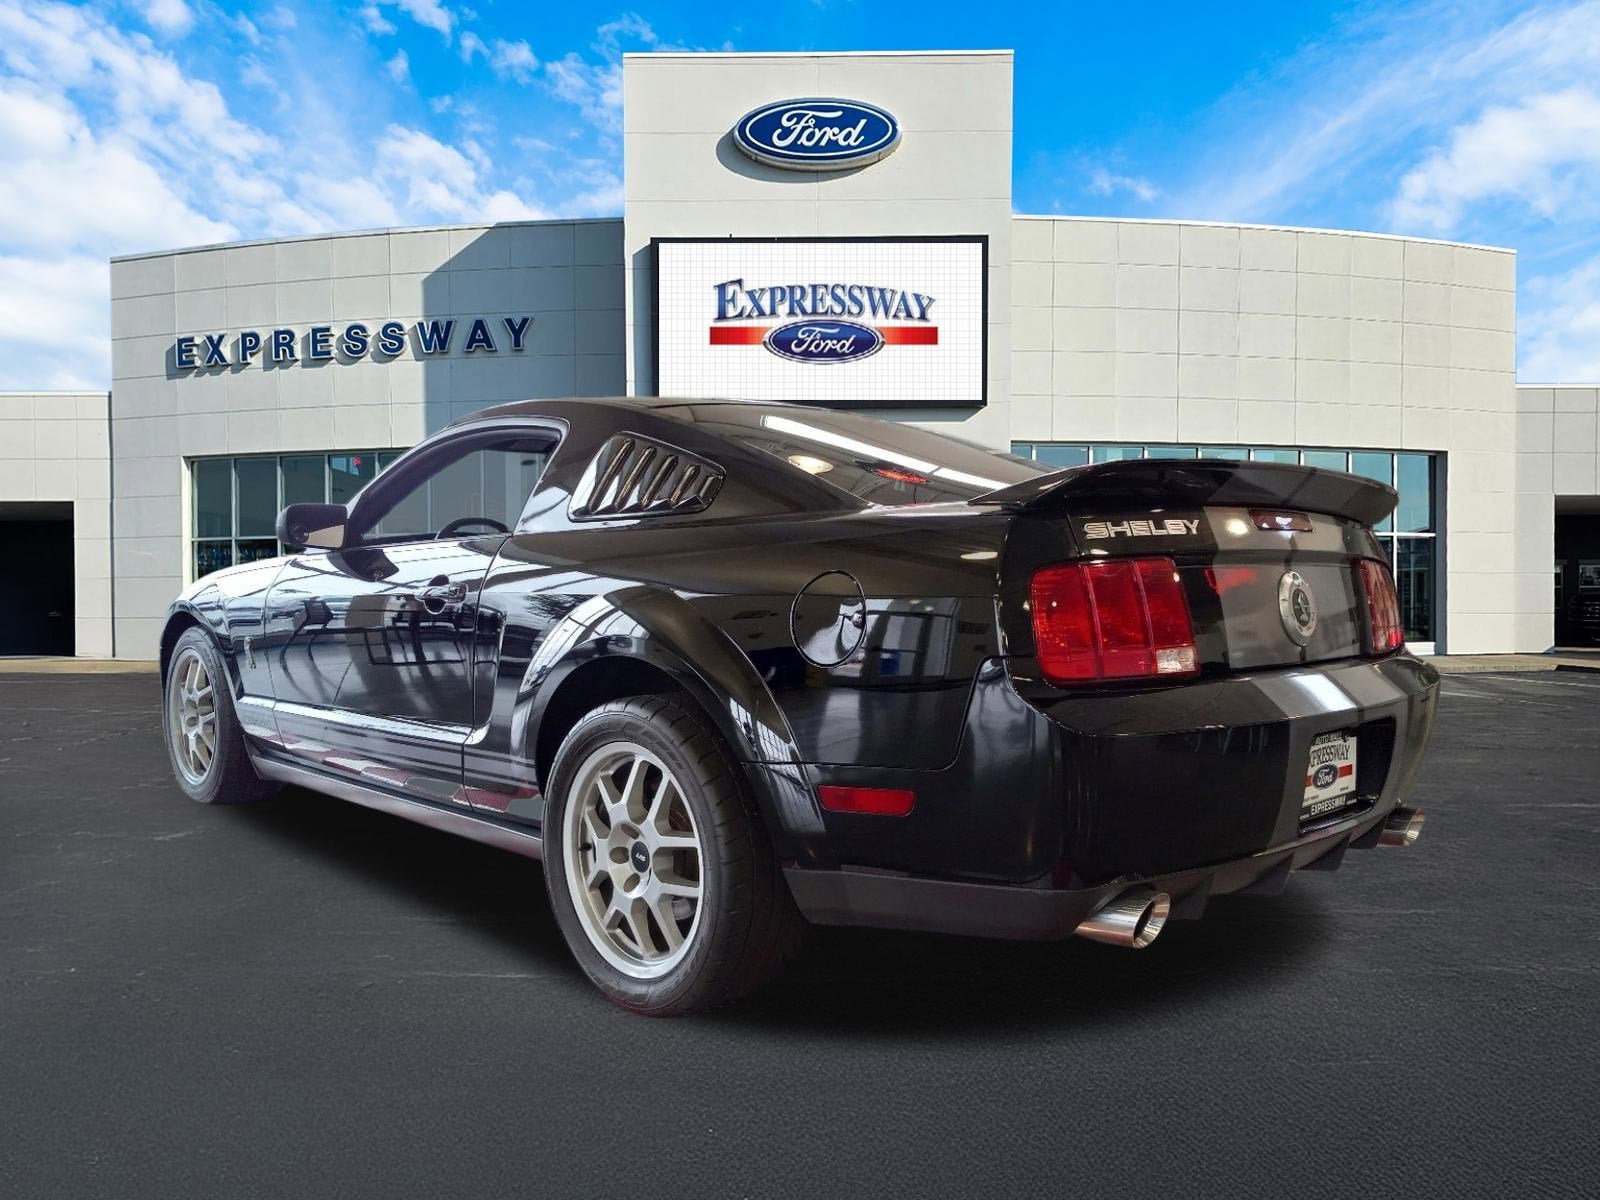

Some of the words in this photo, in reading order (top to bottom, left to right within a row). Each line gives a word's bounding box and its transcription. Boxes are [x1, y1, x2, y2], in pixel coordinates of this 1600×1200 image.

[771, 109, 867, 147] Ford
[713, 278, 936, 322] EXPRESSWAY
[175, 317, 532, 369] EXPRESSWAY
[791, 326, 856, 354] Ford
[1084, 519, 1200, 540] SHELBY
[1310, 744, 1350, 767] PRESSWAY
[1317, 768, 1334, 786] Ford
